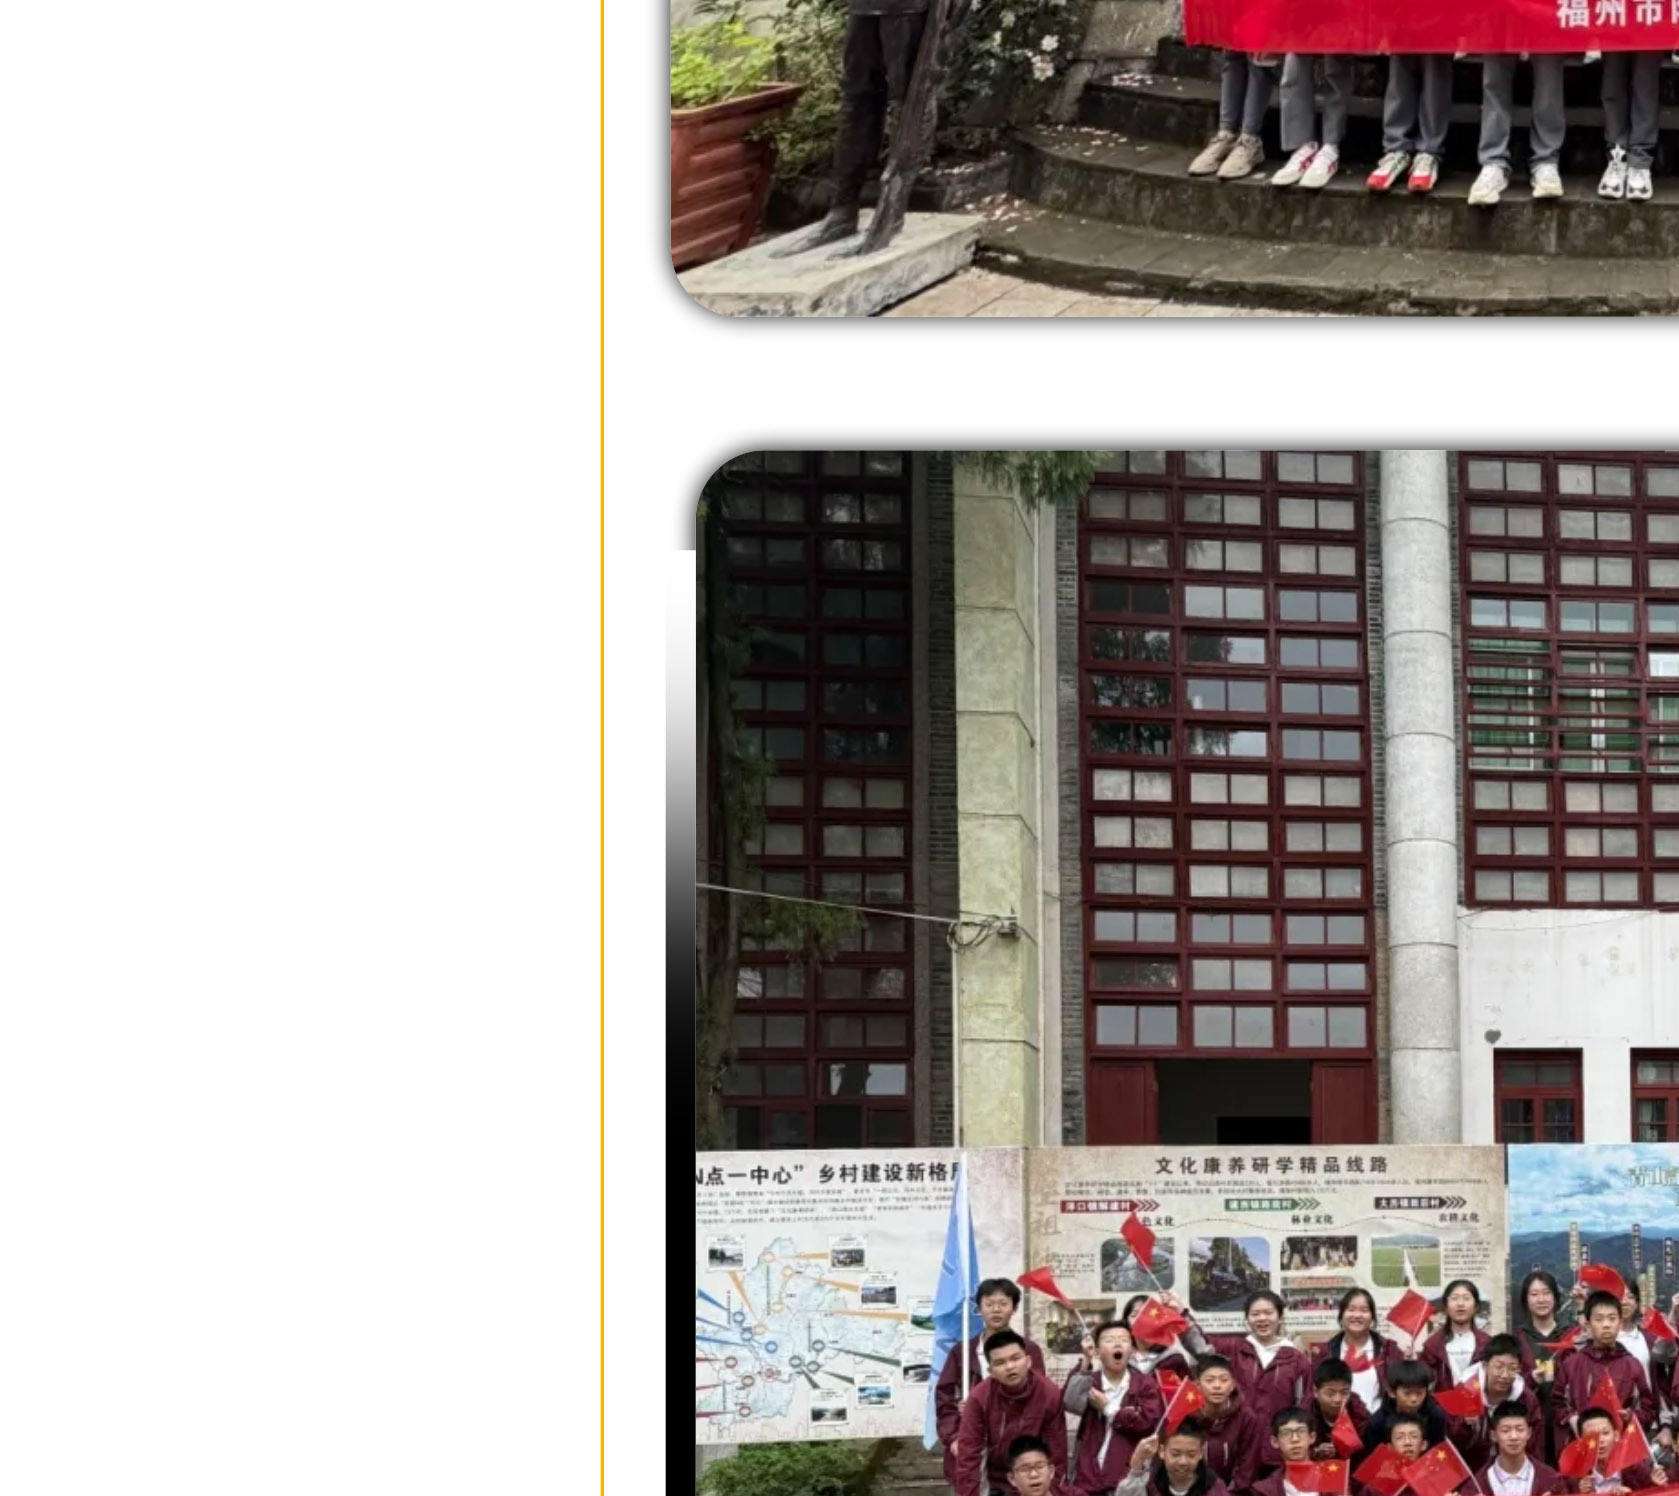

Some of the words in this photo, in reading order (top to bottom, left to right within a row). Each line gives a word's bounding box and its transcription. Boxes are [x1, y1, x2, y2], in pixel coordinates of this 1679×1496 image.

[1156, 1155, 1388, 1174] 文化康养研学精品线路
